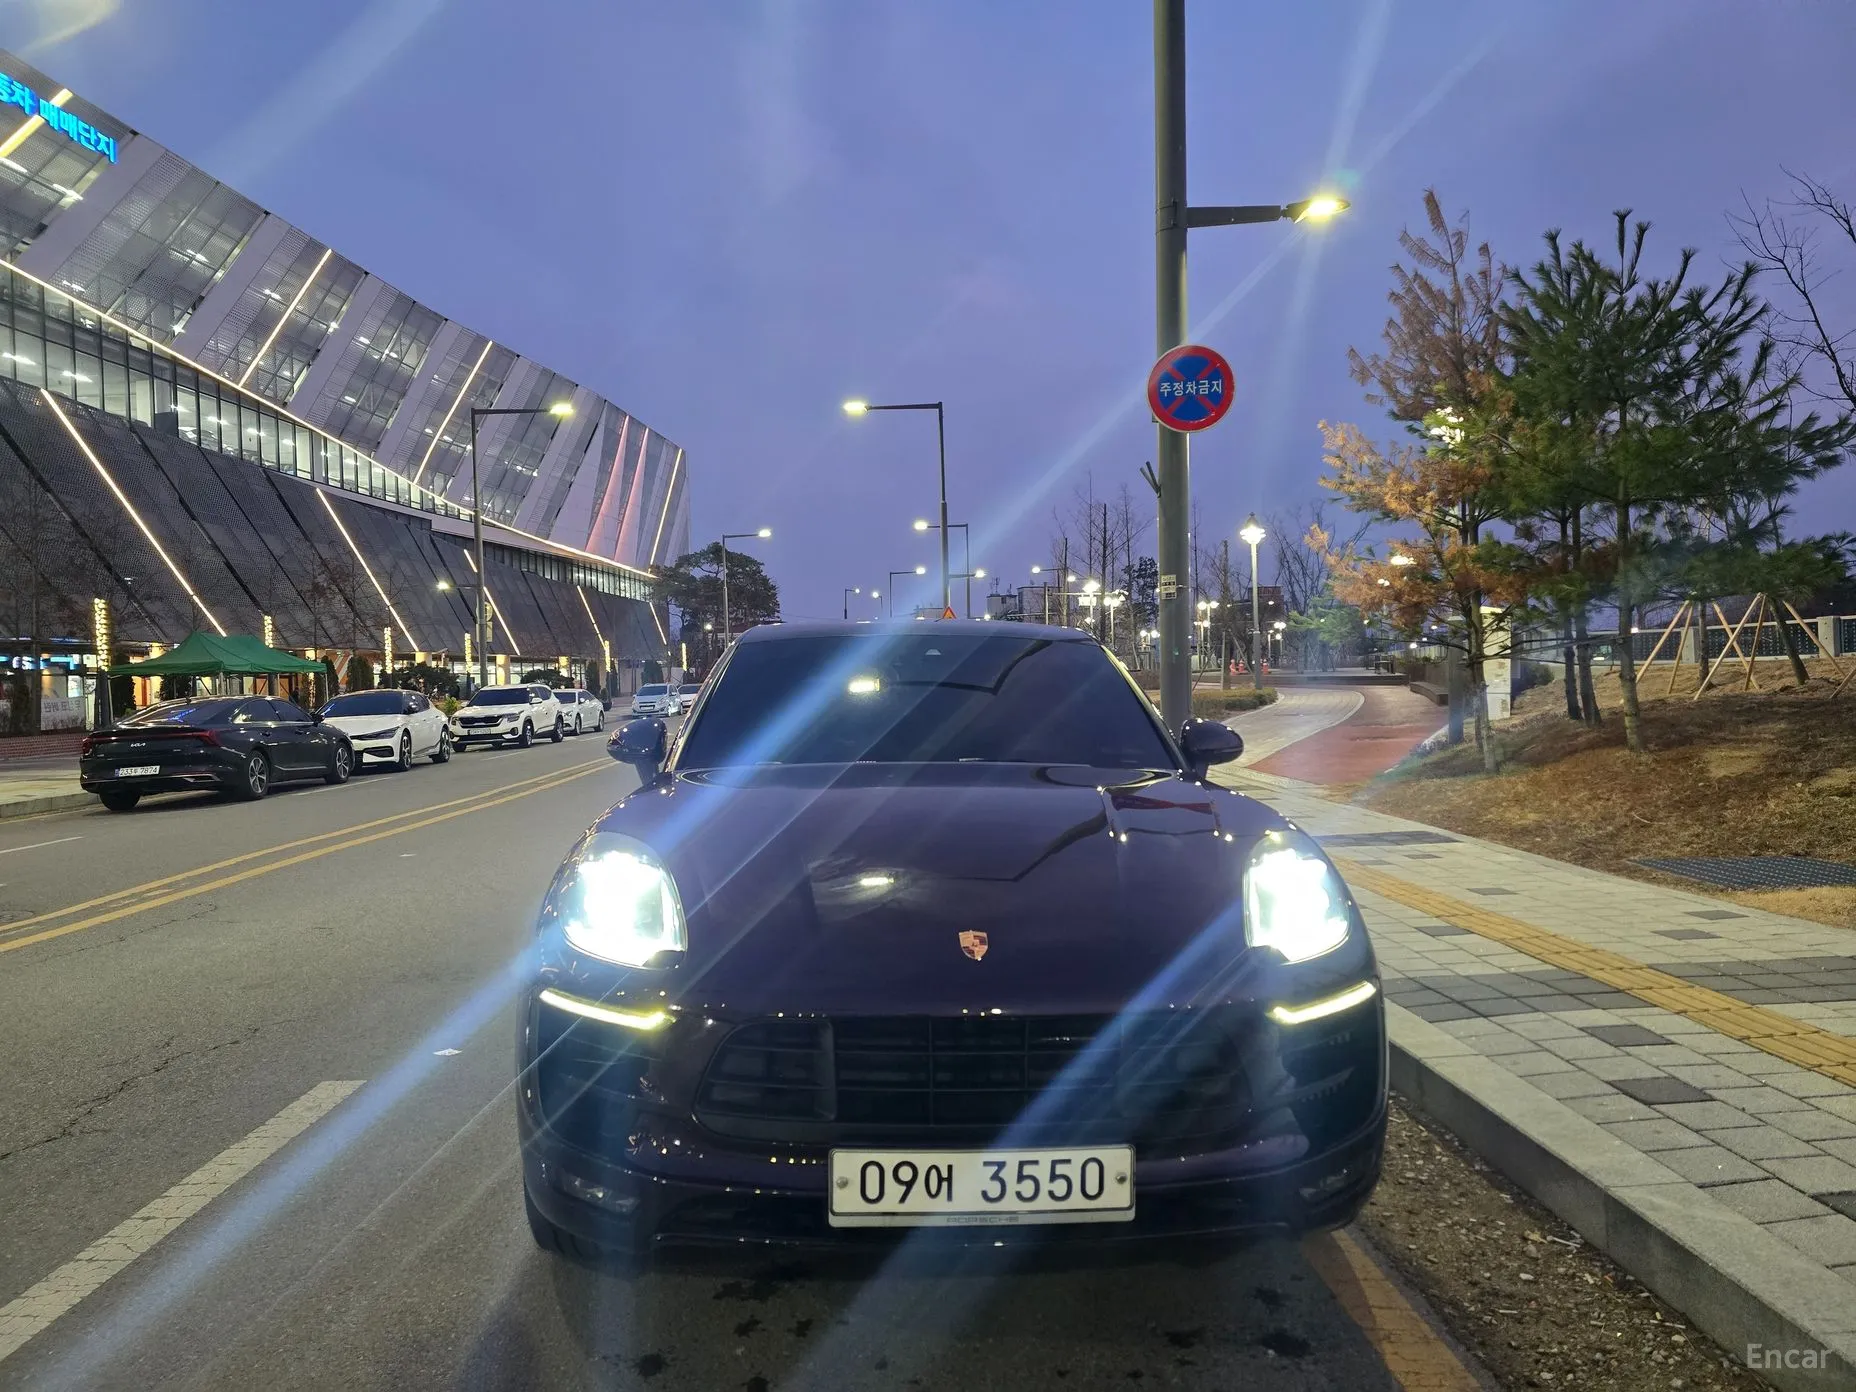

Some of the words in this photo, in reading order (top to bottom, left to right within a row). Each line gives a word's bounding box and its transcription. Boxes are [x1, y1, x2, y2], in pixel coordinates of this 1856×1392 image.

[39, 98, 118, 164] 매매단지
[1160, 379, 1222, 397] 주정차금지
[859, 1160, 953, 1205] 09어
[980, 1157, 1105, 1203] 3550
